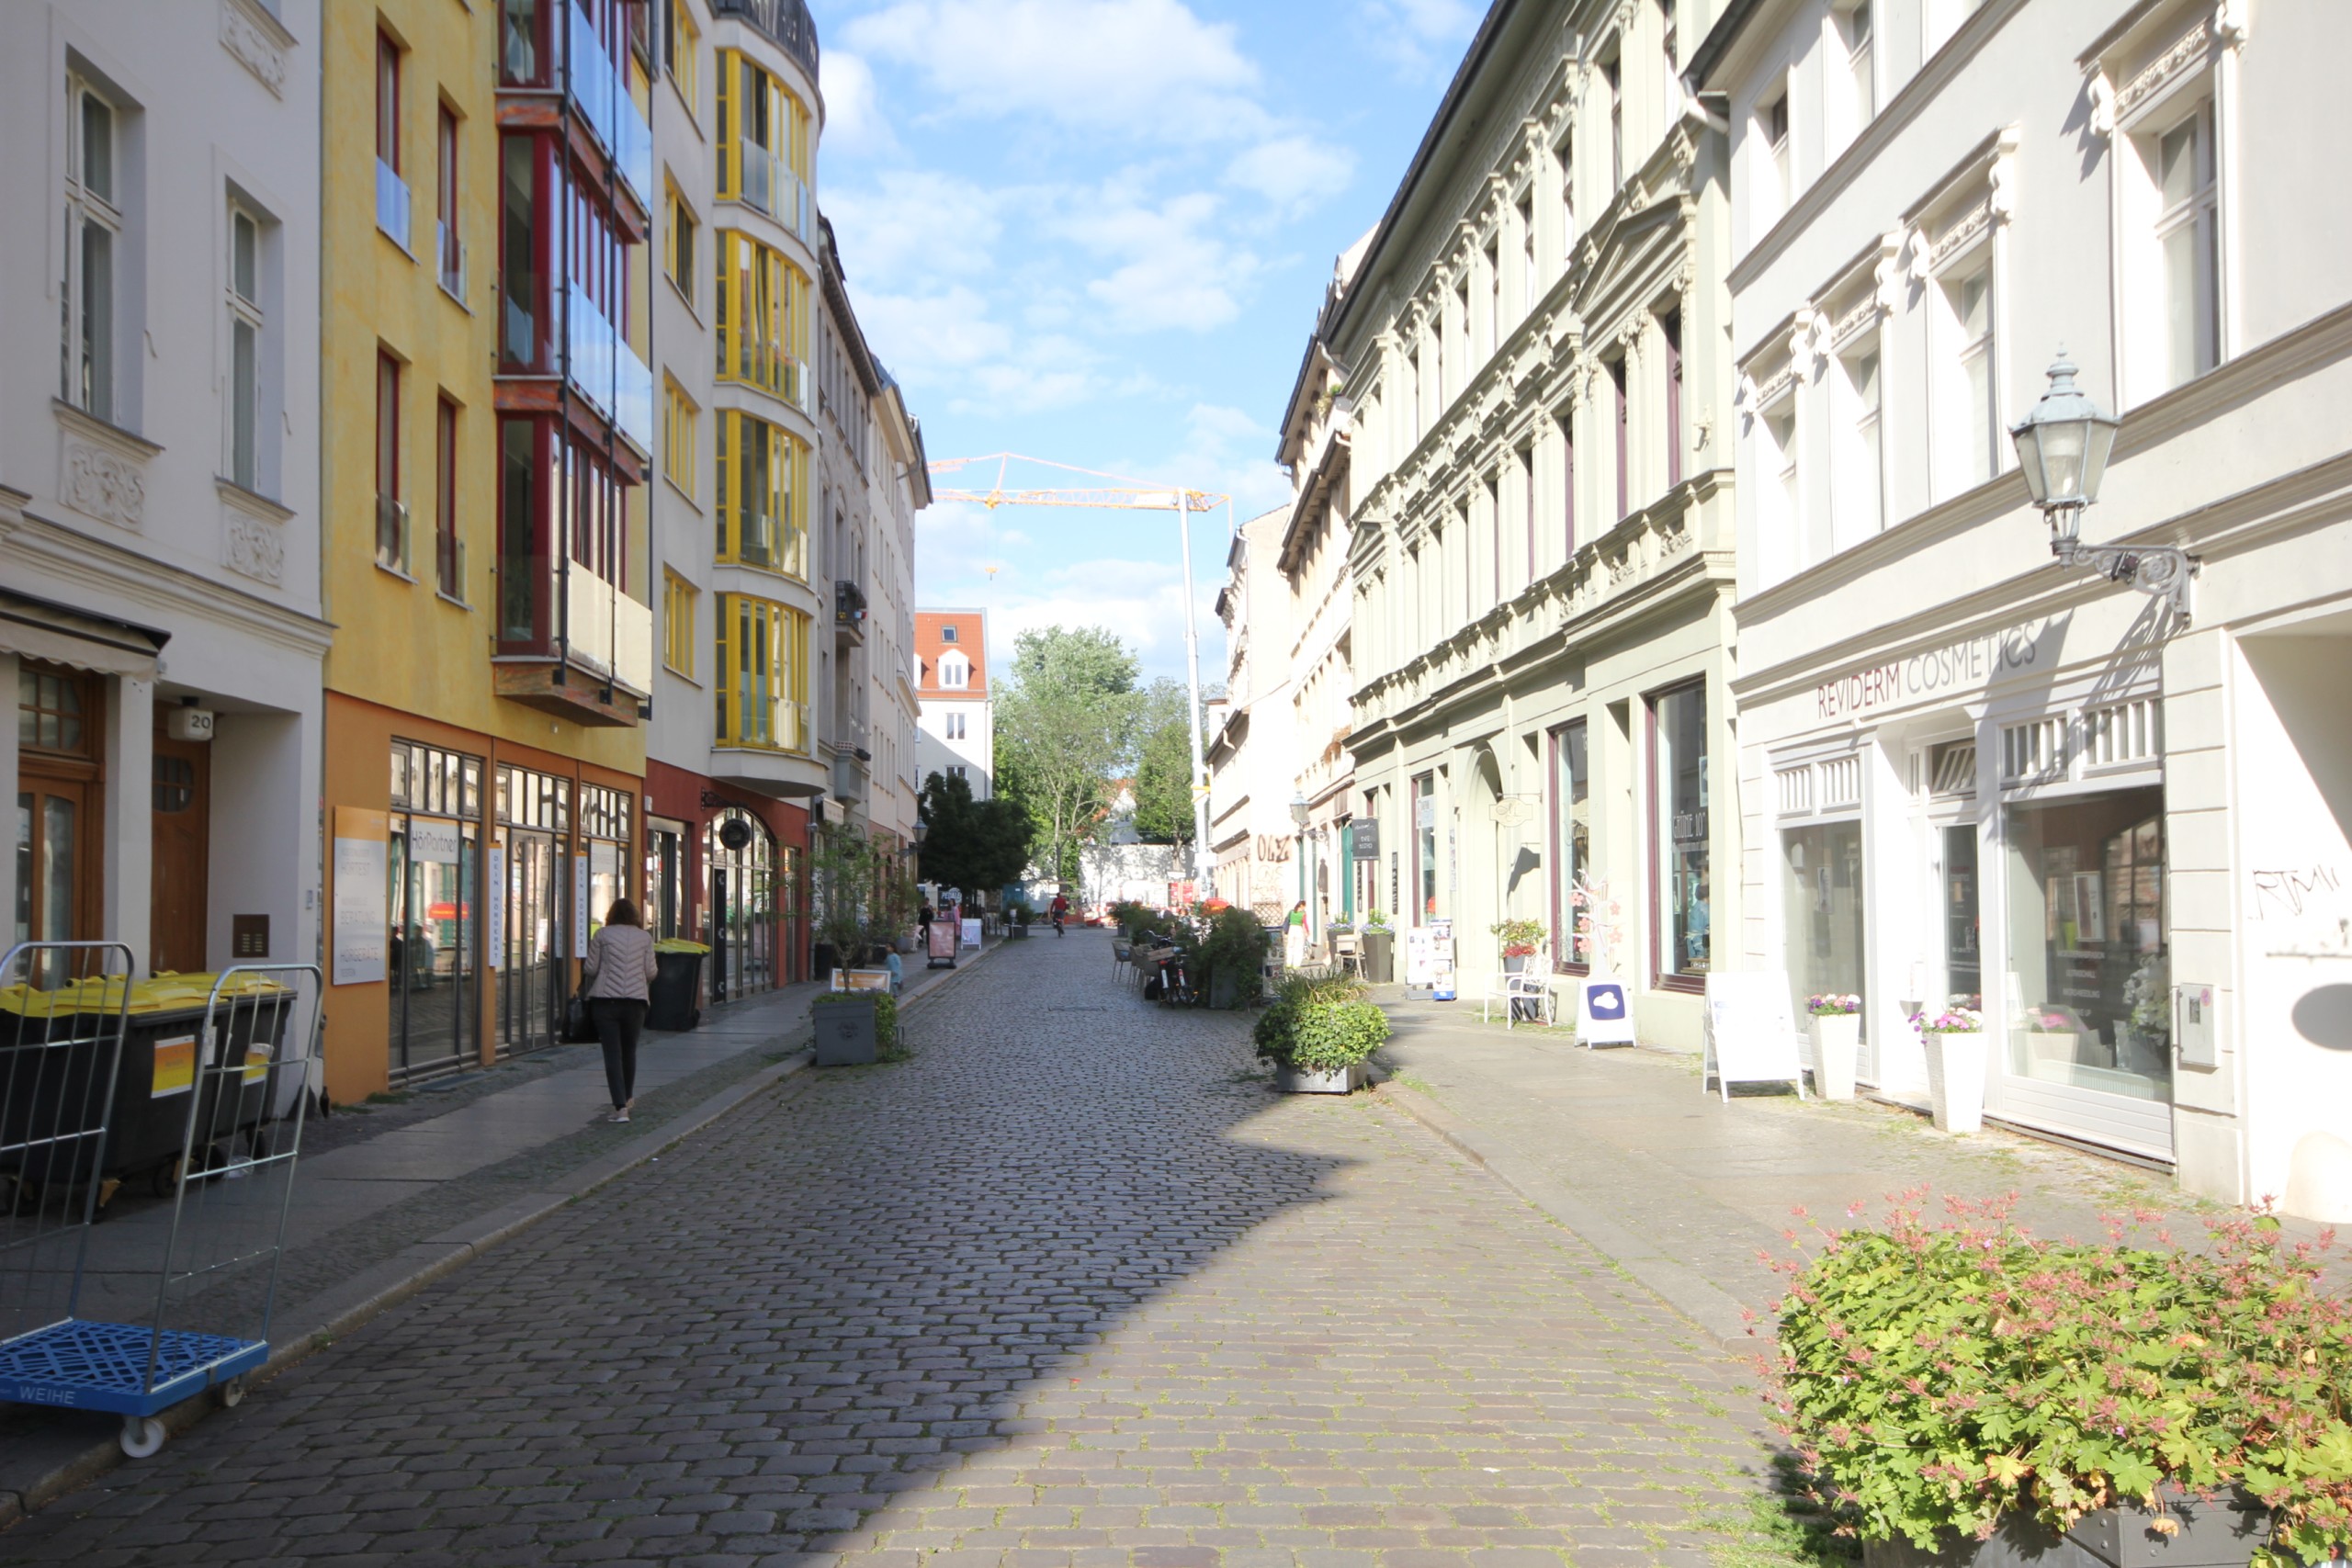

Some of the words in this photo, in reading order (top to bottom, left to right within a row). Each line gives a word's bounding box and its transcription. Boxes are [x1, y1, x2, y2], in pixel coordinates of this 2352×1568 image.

[1817, 661, 1900, 719] REVIDERM
[1906, 621, 2036, 694] COSMETICS
[191, 715, 211, 729] 20
[1673, 810, 1693, 838] GRÜNE
[412, 830, 457, 853] HörPartner
[19, 1385, 76, 1404] WEIHE
